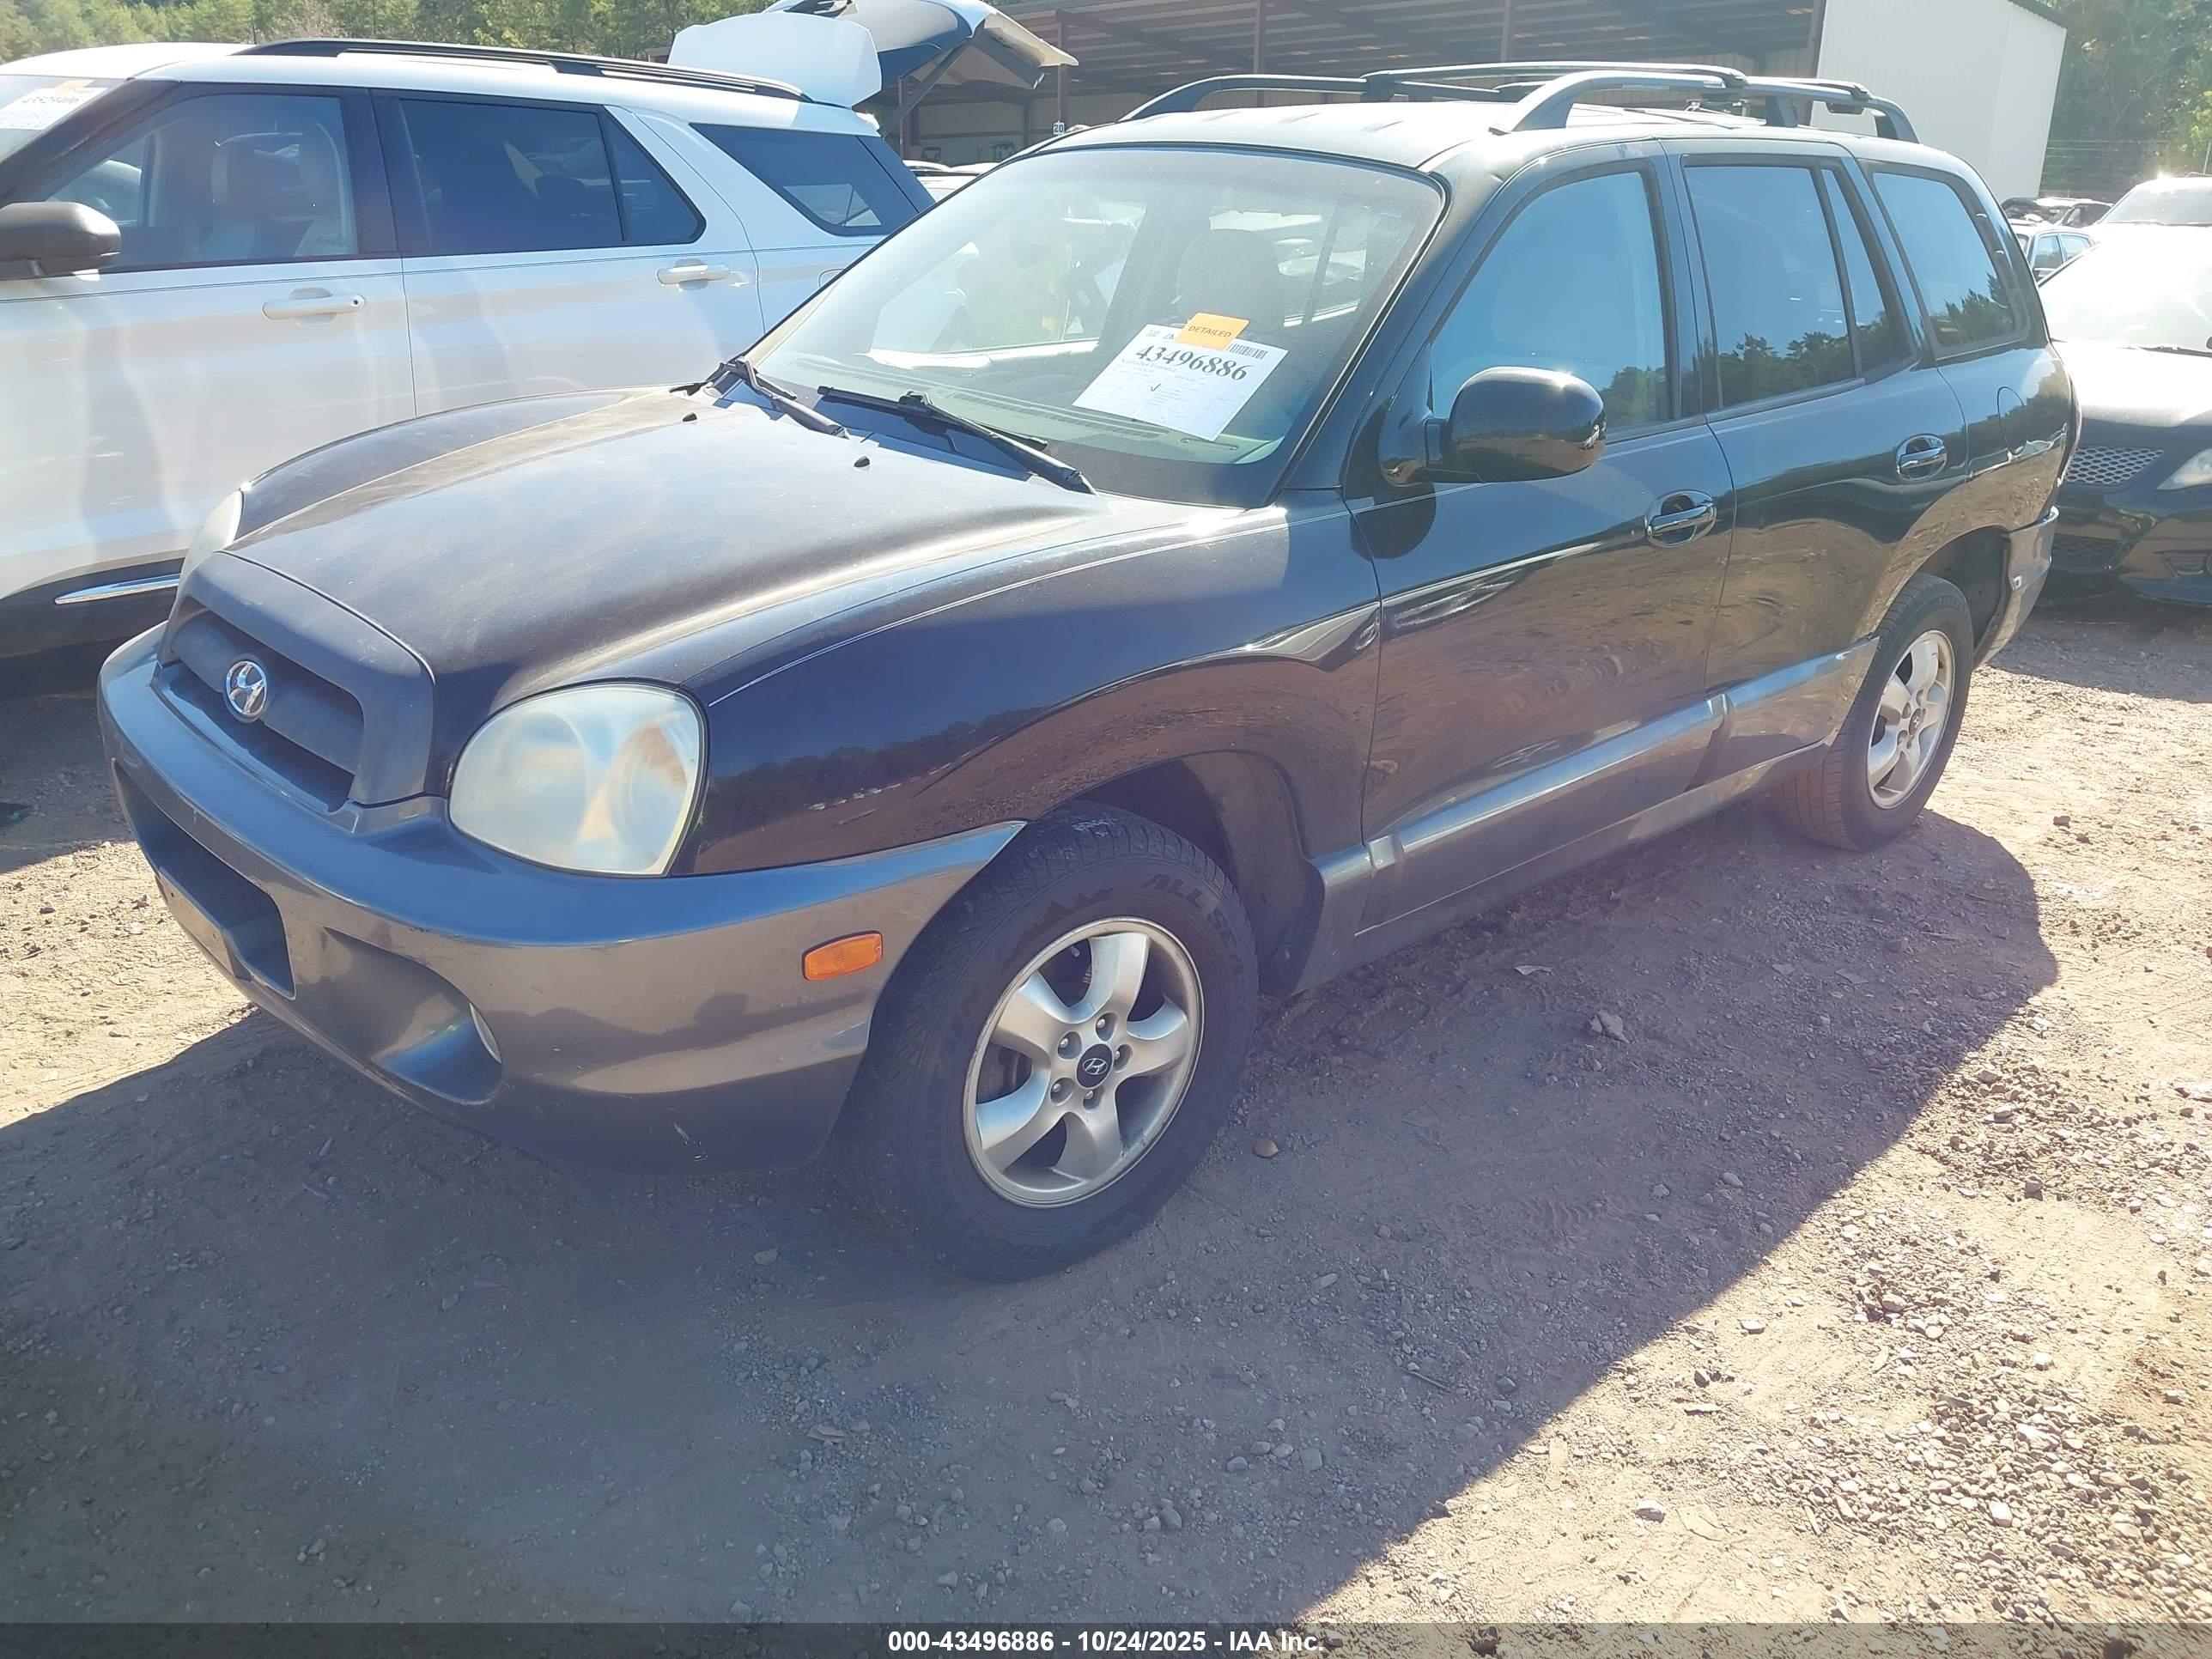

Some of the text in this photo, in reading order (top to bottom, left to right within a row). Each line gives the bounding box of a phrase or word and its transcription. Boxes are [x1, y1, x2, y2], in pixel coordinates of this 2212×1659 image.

[1054, 125, 1064, 133] 20
[1187, 325, 1232, 338] DETAILED
[1135, 345, 1255, 380] 43496886
[1140, 872, 1203, 908] ALL
